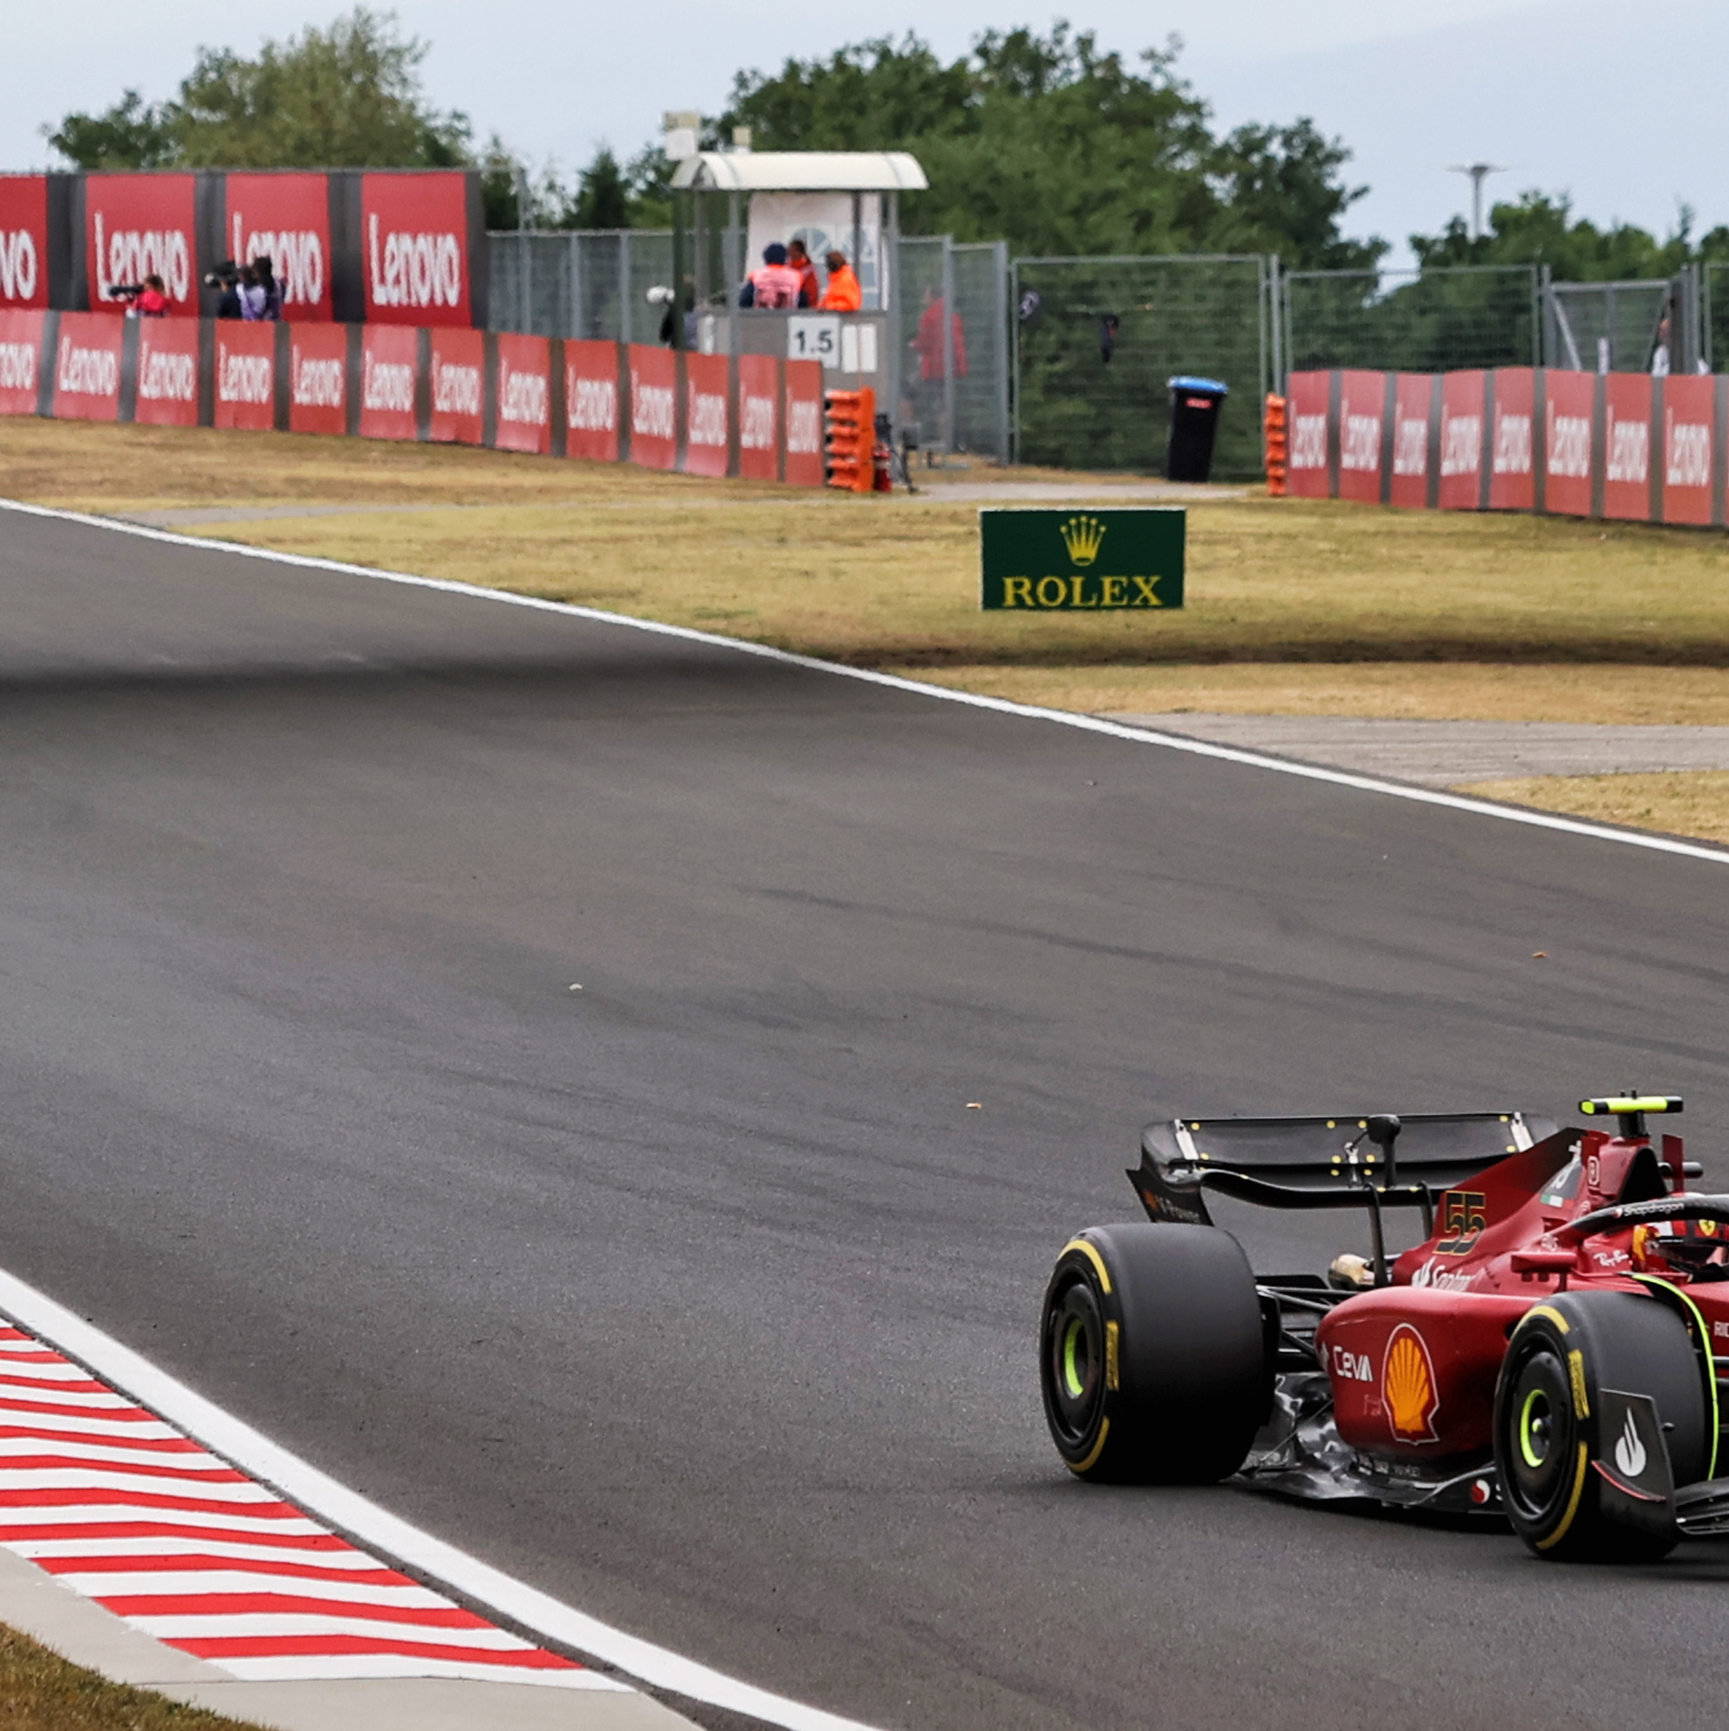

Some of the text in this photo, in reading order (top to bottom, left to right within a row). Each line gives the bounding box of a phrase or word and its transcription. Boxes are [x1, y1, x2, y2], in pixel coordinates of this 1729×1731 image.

[59, 336, 117, 395] Lenovo
[140, 340, 194, 399] Lenovo
[794, 330, 833, 353] 1.5
[219, 343, 271, 403] Lenovo
[1002, 576, 1163, 609] ROLEX
[1432, 1190, 1486, 1256] 55
